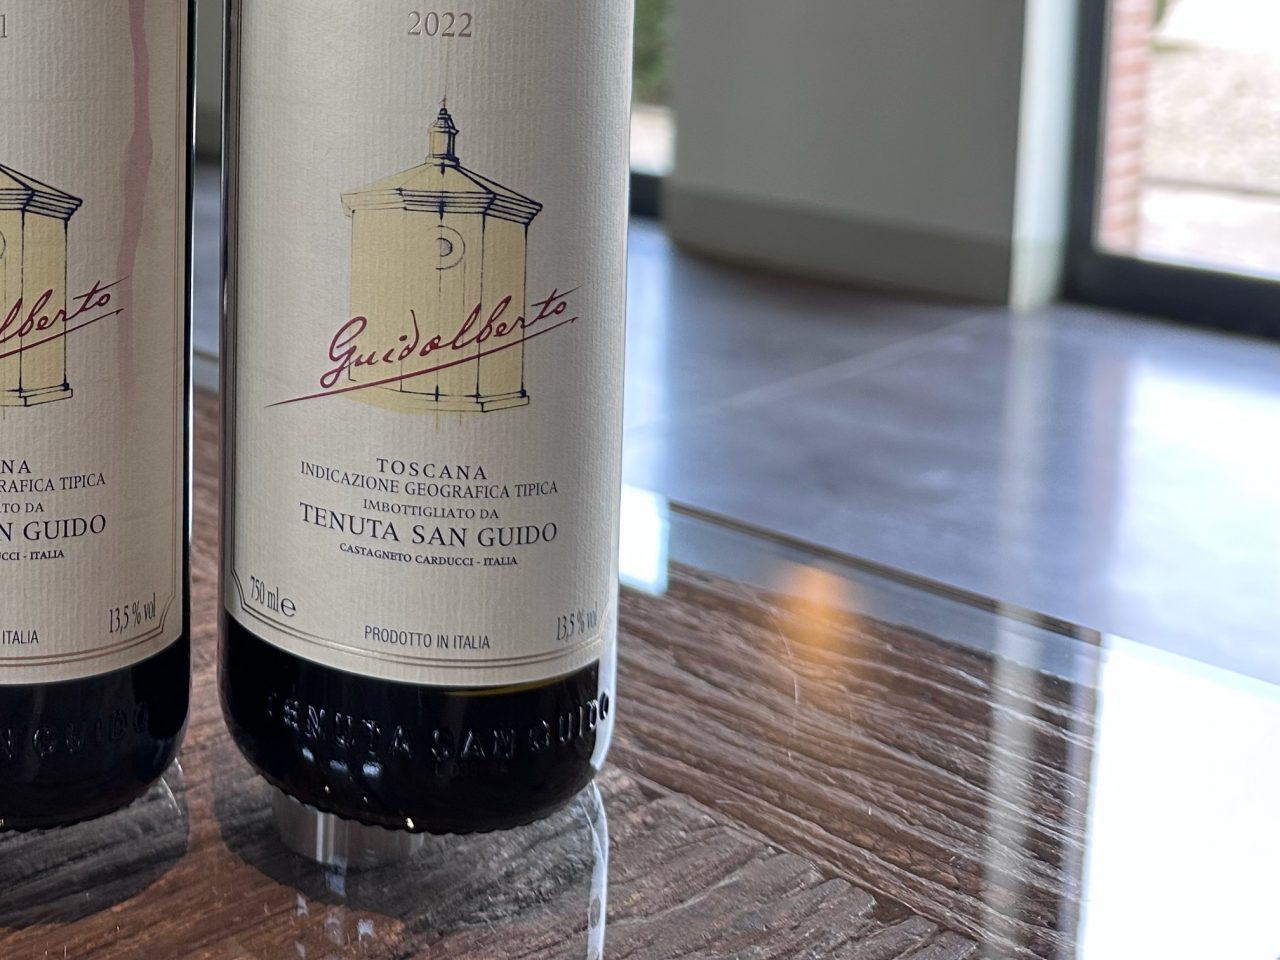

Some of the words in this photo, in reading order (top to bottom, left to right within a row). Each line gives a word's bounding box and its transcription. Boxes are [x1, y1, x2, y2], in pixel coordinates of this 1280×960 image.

[408, 10, 472, 38] 2022
[320, 284, 583, 388] Guidalberto
[59, 472, 106, 490] TIPICA
[301, 461, 399, 493] INDICAZIONE
[405, 482, 510, 499] GEOGRAFICA
[515, 480, 558, 497] TIPICA
[376, 458, 487, 480] TOSCANA
[24, 502, 44, 513] DA
[363, 498, 475, 519] IMBOTTIGLIATO
[479, 508, 499, 519] DA
[23, 514, 107, 541] GUIDO
[300, 501, 400, 542] TENUTA
[412, 524, 467, 547] SAN
[477, 522, 558, 547] GUIDO
[30, 550, 64, 561] ITALIA
[339, 542, 412, 562] CASTAGNETO
[415, 555, 473, 566] CARDUCCI
[483, 556, 518, 566] ITALIA
[250, 575, 265, 605] 750
[144, 592, 156, 619] vol
[2, 629, 39, 645] ITALIA
[364, 625, 432, 648] PRODOTTO
[437, 633, 449, 649] IN
[453, 634, 490, 650] ITALIA
